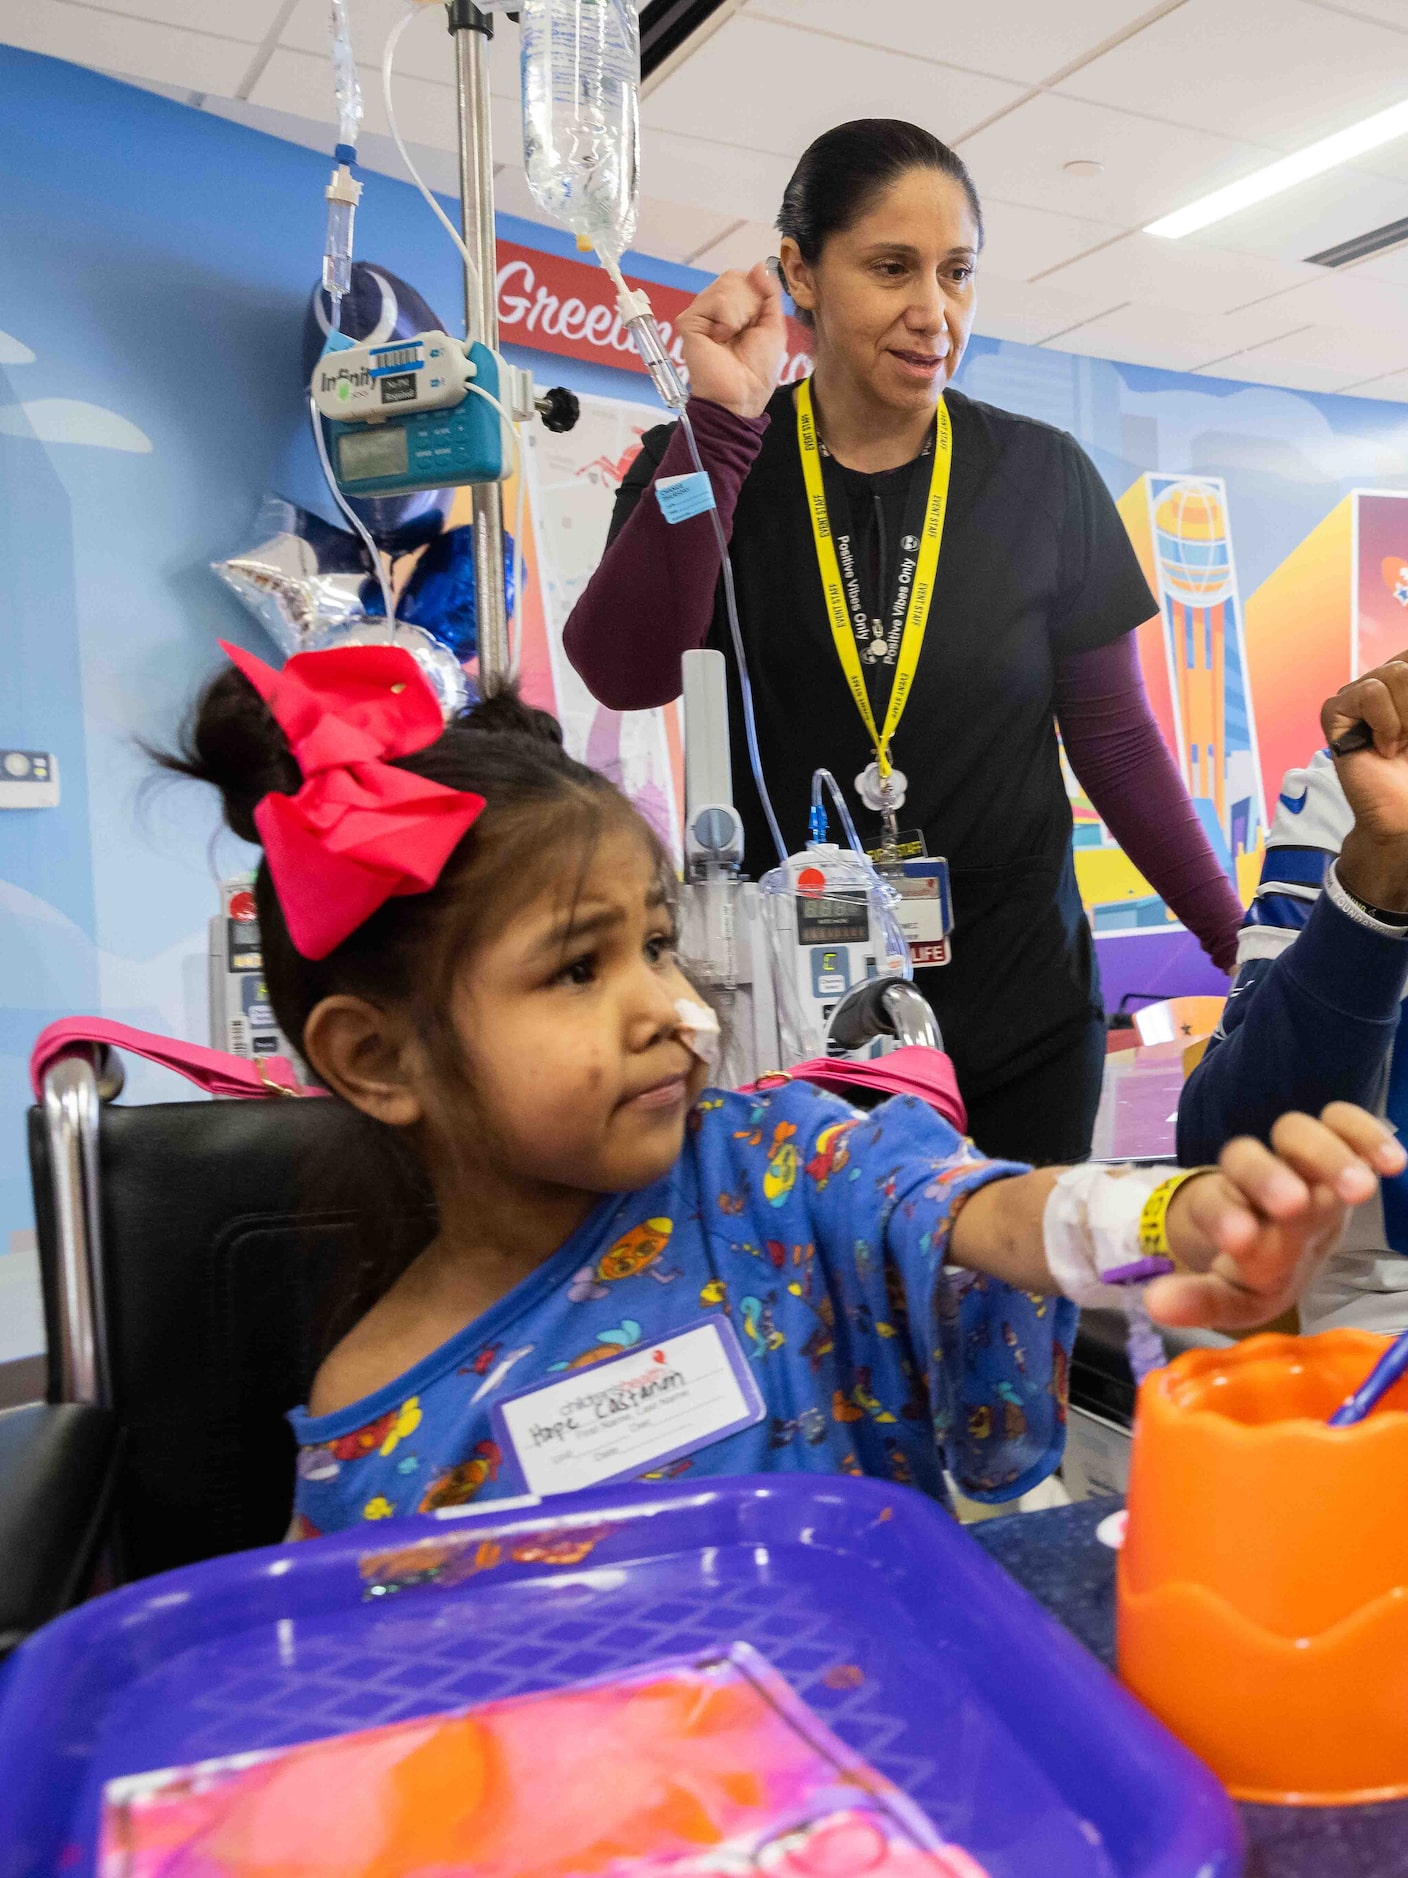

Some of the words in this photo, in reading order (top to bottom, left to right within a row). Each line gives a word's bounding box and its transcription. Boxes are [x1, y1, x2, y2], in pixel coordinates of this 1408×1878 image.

[813, 494, 828, 515] STAFF
[930, 494, 942, 516] EVENT
[817, 515, 830, 538] EVENT
[927, 516, 940, 539] STAFF
[837, 534, 855, 579] Positive
[897, 557, 917, 585] Only
[828, 582, 842, 605] STAFF
[846, 578, 861, 612] Vibes
[891, 586, 910, 617] Vibes
[917, 582, 929, 605] EVENT
[832, 605, 846, 628] EVENT
[853, 612, 870, 641] Only
[912, 605, 925, 628] STAFF
[882, 619, 903, 665] Positive
